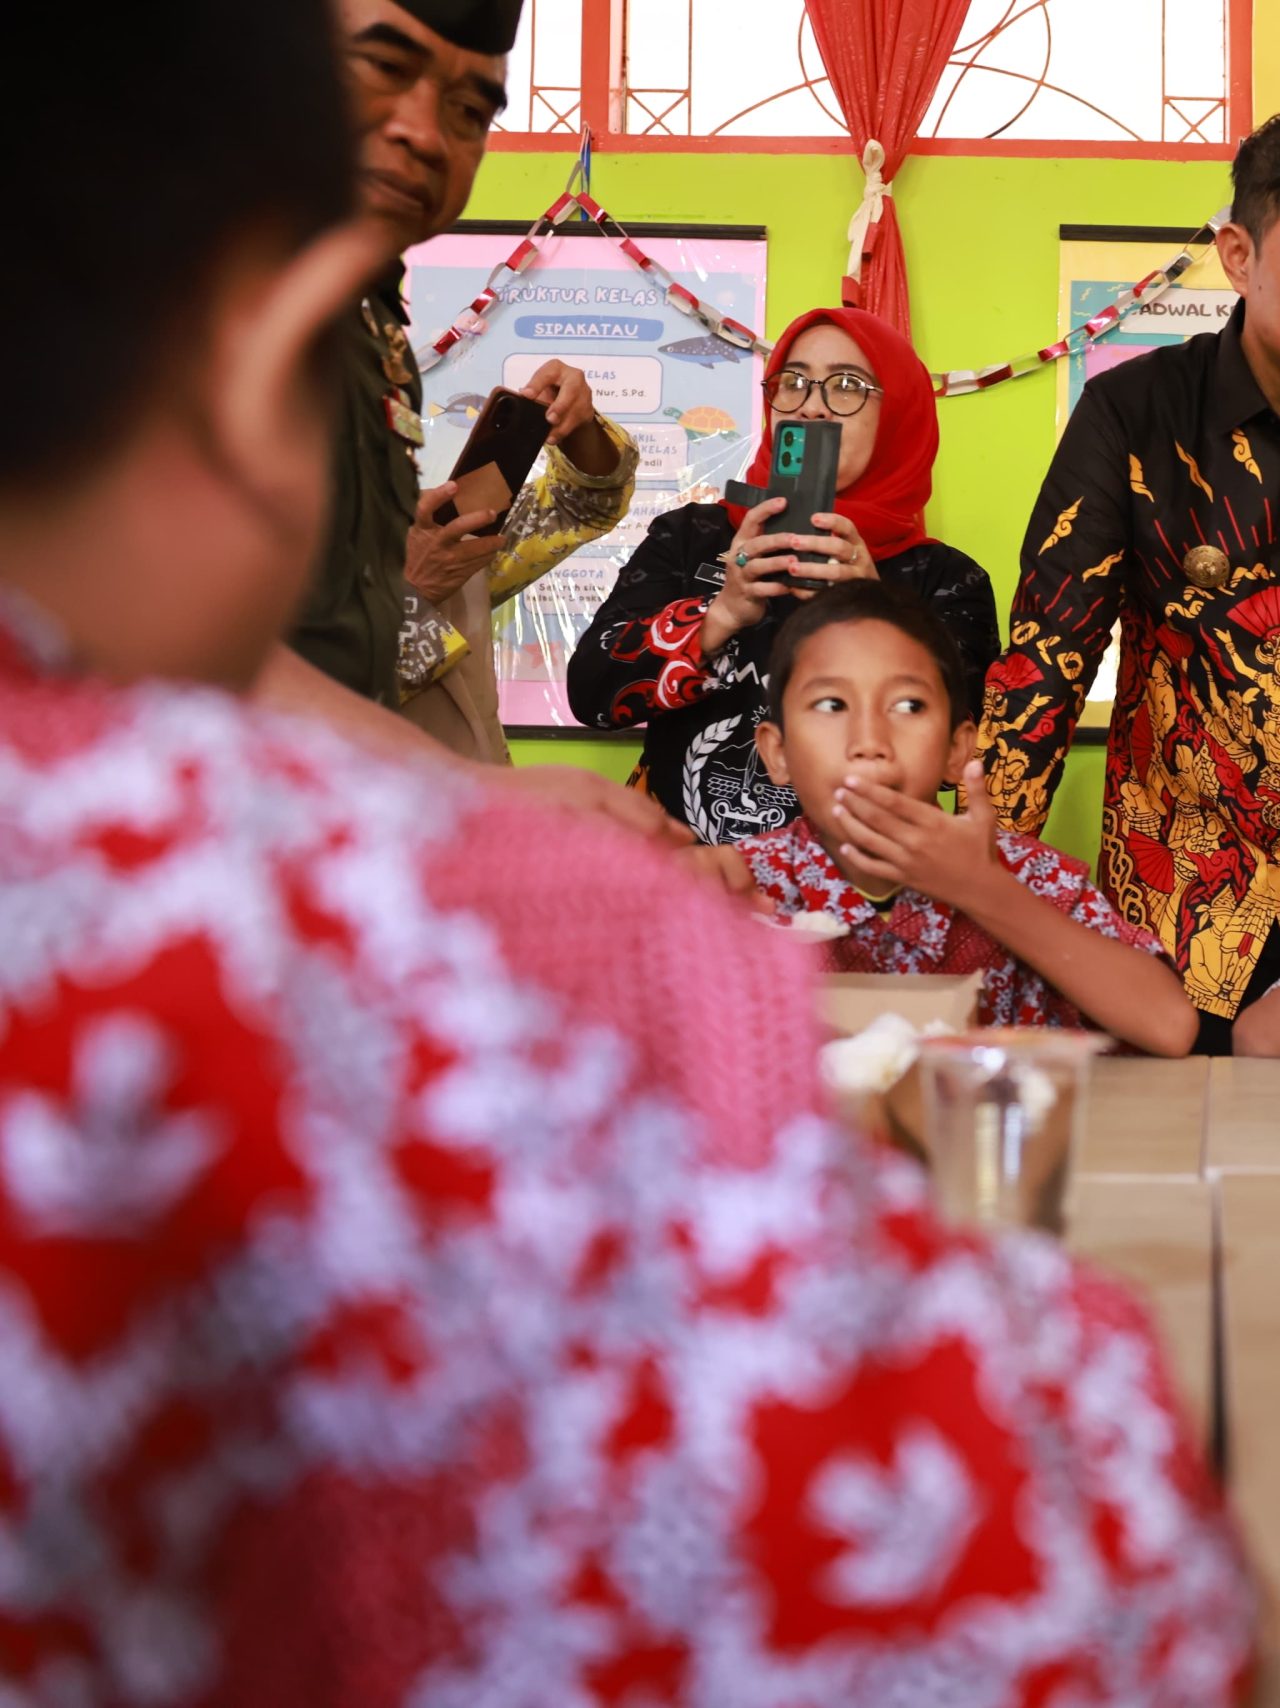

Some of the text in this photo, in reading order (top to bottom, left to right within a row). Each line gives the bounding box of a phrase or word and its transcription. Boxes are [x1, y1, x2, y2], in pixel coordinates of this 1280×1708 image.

[594, 285, 658, 307] KELAS
[533, 322, 639, 337] SIPAKATAU
[583, 370, 616, 380] ELAS
[596, 388, 619, 398] Nur,
[641, 445, 678, 456] KELAS
